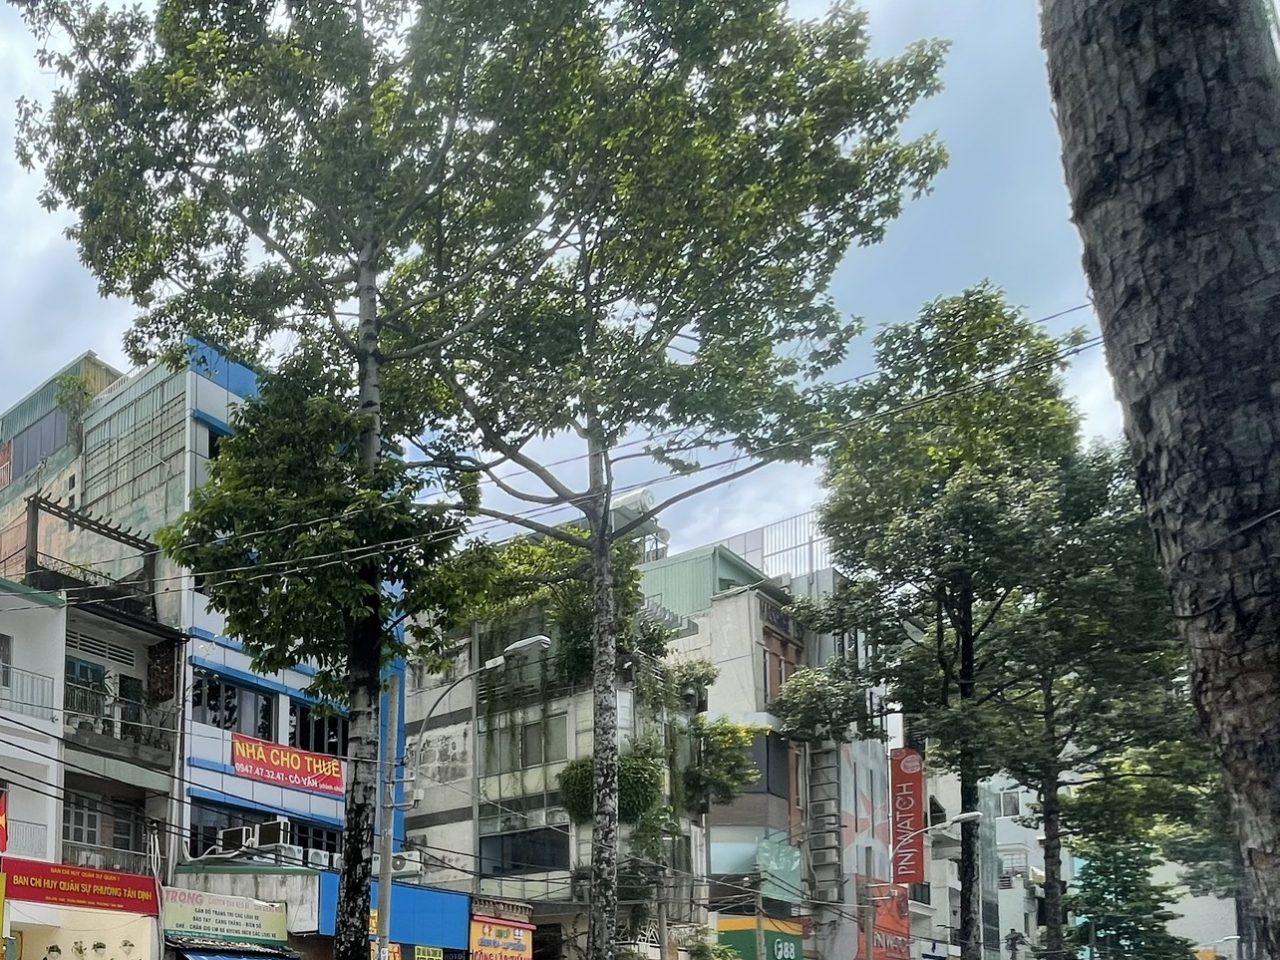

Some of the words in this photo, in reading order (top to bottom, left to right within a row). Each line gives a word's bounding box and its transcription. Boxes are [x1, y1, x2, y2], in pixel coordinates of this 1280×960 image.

[235, 740, 266, 762] NHÀ
[270, 749, 301, 770] CHO
[305, 757, 341, 778] THUÊ
[13, 874, 29, 886] BAN
[43, 879, 58, 890] HUY
[59, 880, 80, 892] QUÂN
